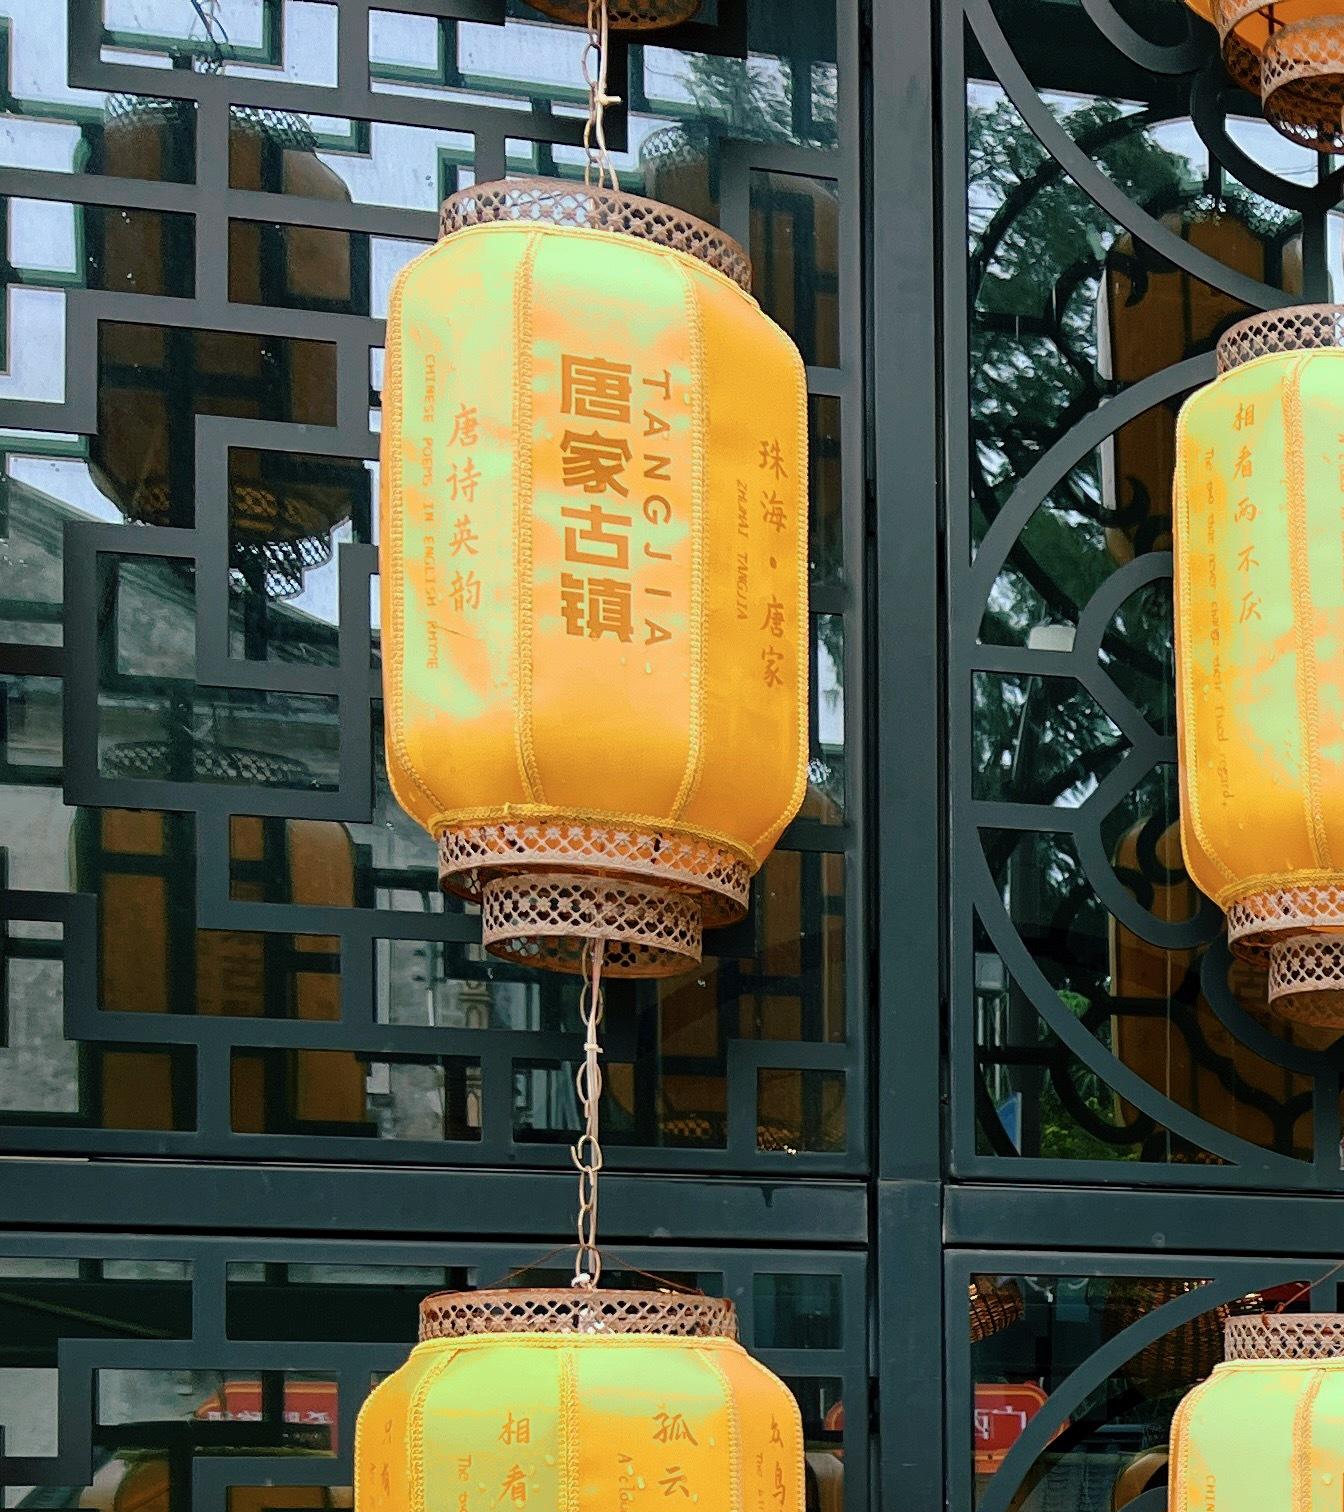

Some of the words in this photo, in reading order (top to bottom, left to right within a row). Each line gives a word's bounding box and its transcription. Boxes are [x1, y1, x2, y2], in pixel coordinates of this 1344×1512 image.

[424, 355, 435, 422] CHINESE
[422, 437, 434, 486] POEMS
[423, 503, 434, 522] IN
[447, 402, 483, 613] 唐诗英韵
[560, 353, 633, 643] 唐家古镇
[643, 370, 672, 646] TANGJIA
[736, 479, 749, 538] ZHUHAI
[1233, 403, 1262, 624] 相看两不厌
[424, 536, 437, 606] ENGLISH
[736, 552, 749, 620] TANGJIA
[426, 621, 439, 669] RHYME
[457, 1455, 471, 1481] The
[617, 1452, 633, 1464] A
